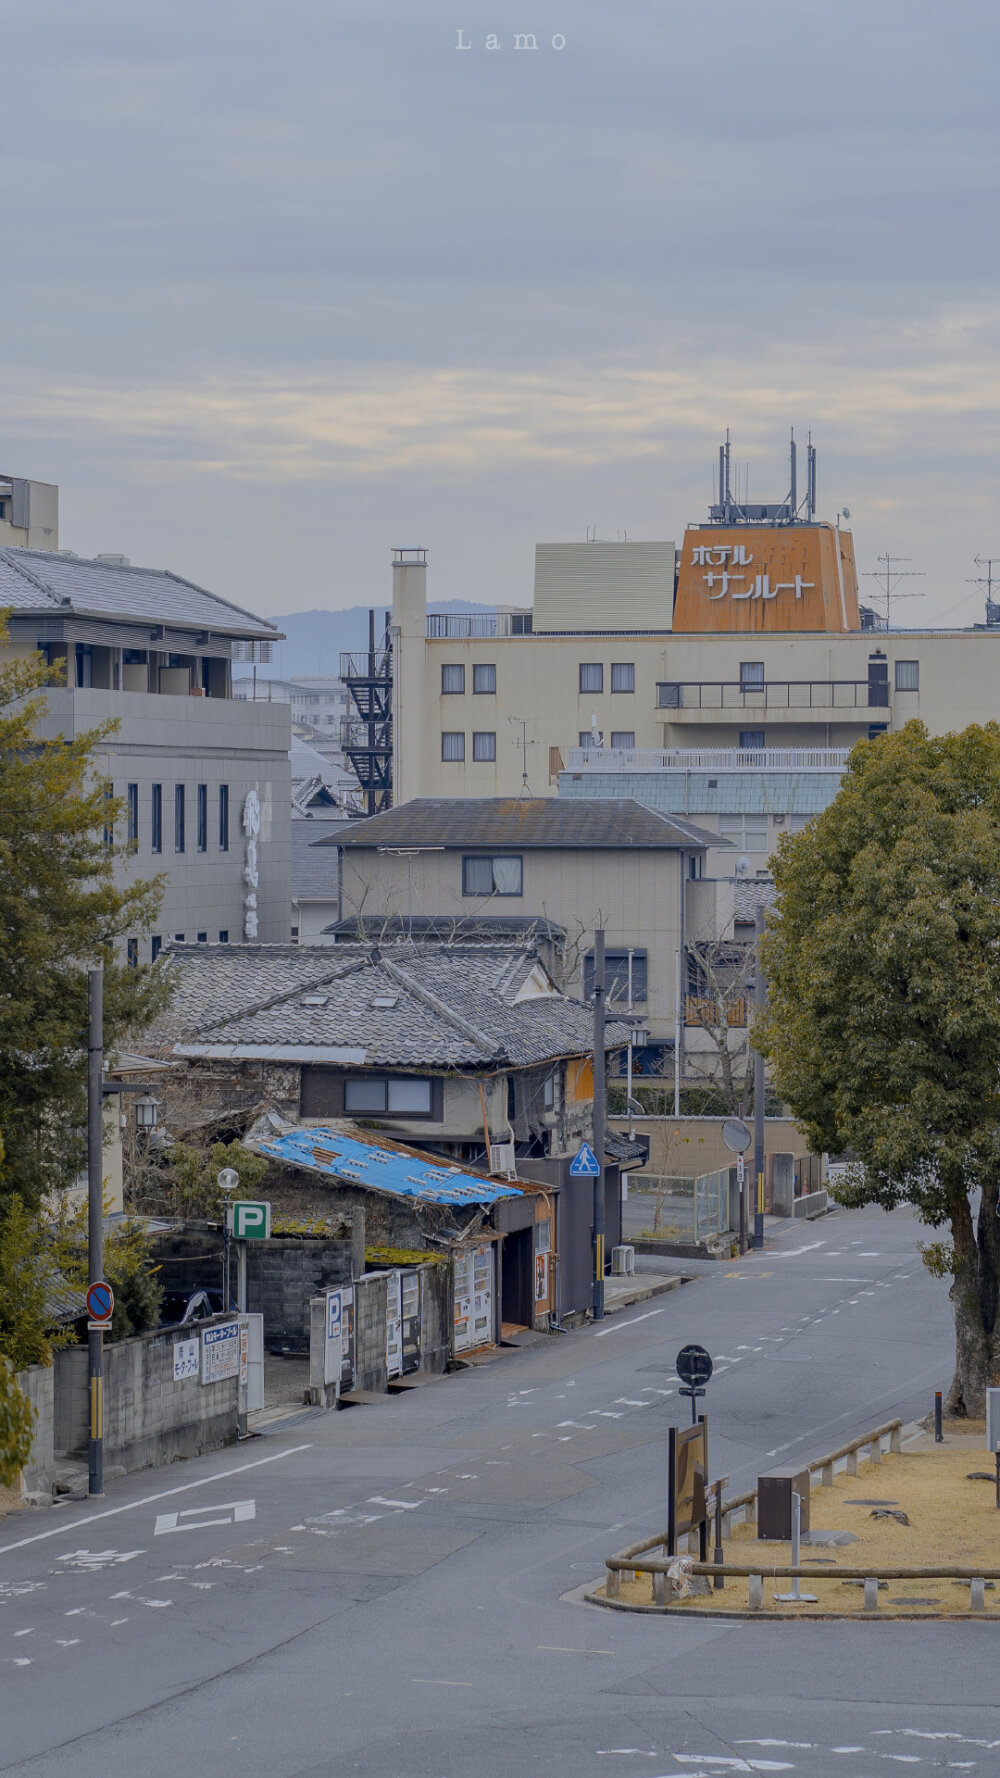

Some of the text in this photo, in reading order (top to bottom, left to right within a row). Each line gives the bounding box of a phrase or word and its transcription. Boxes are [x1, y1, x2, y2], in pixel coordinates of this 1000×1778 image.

[690, 545, 753, 566] ホテル
[702, 571, 815, 600] サンルート
[238, 1207, 263, 1236] P
